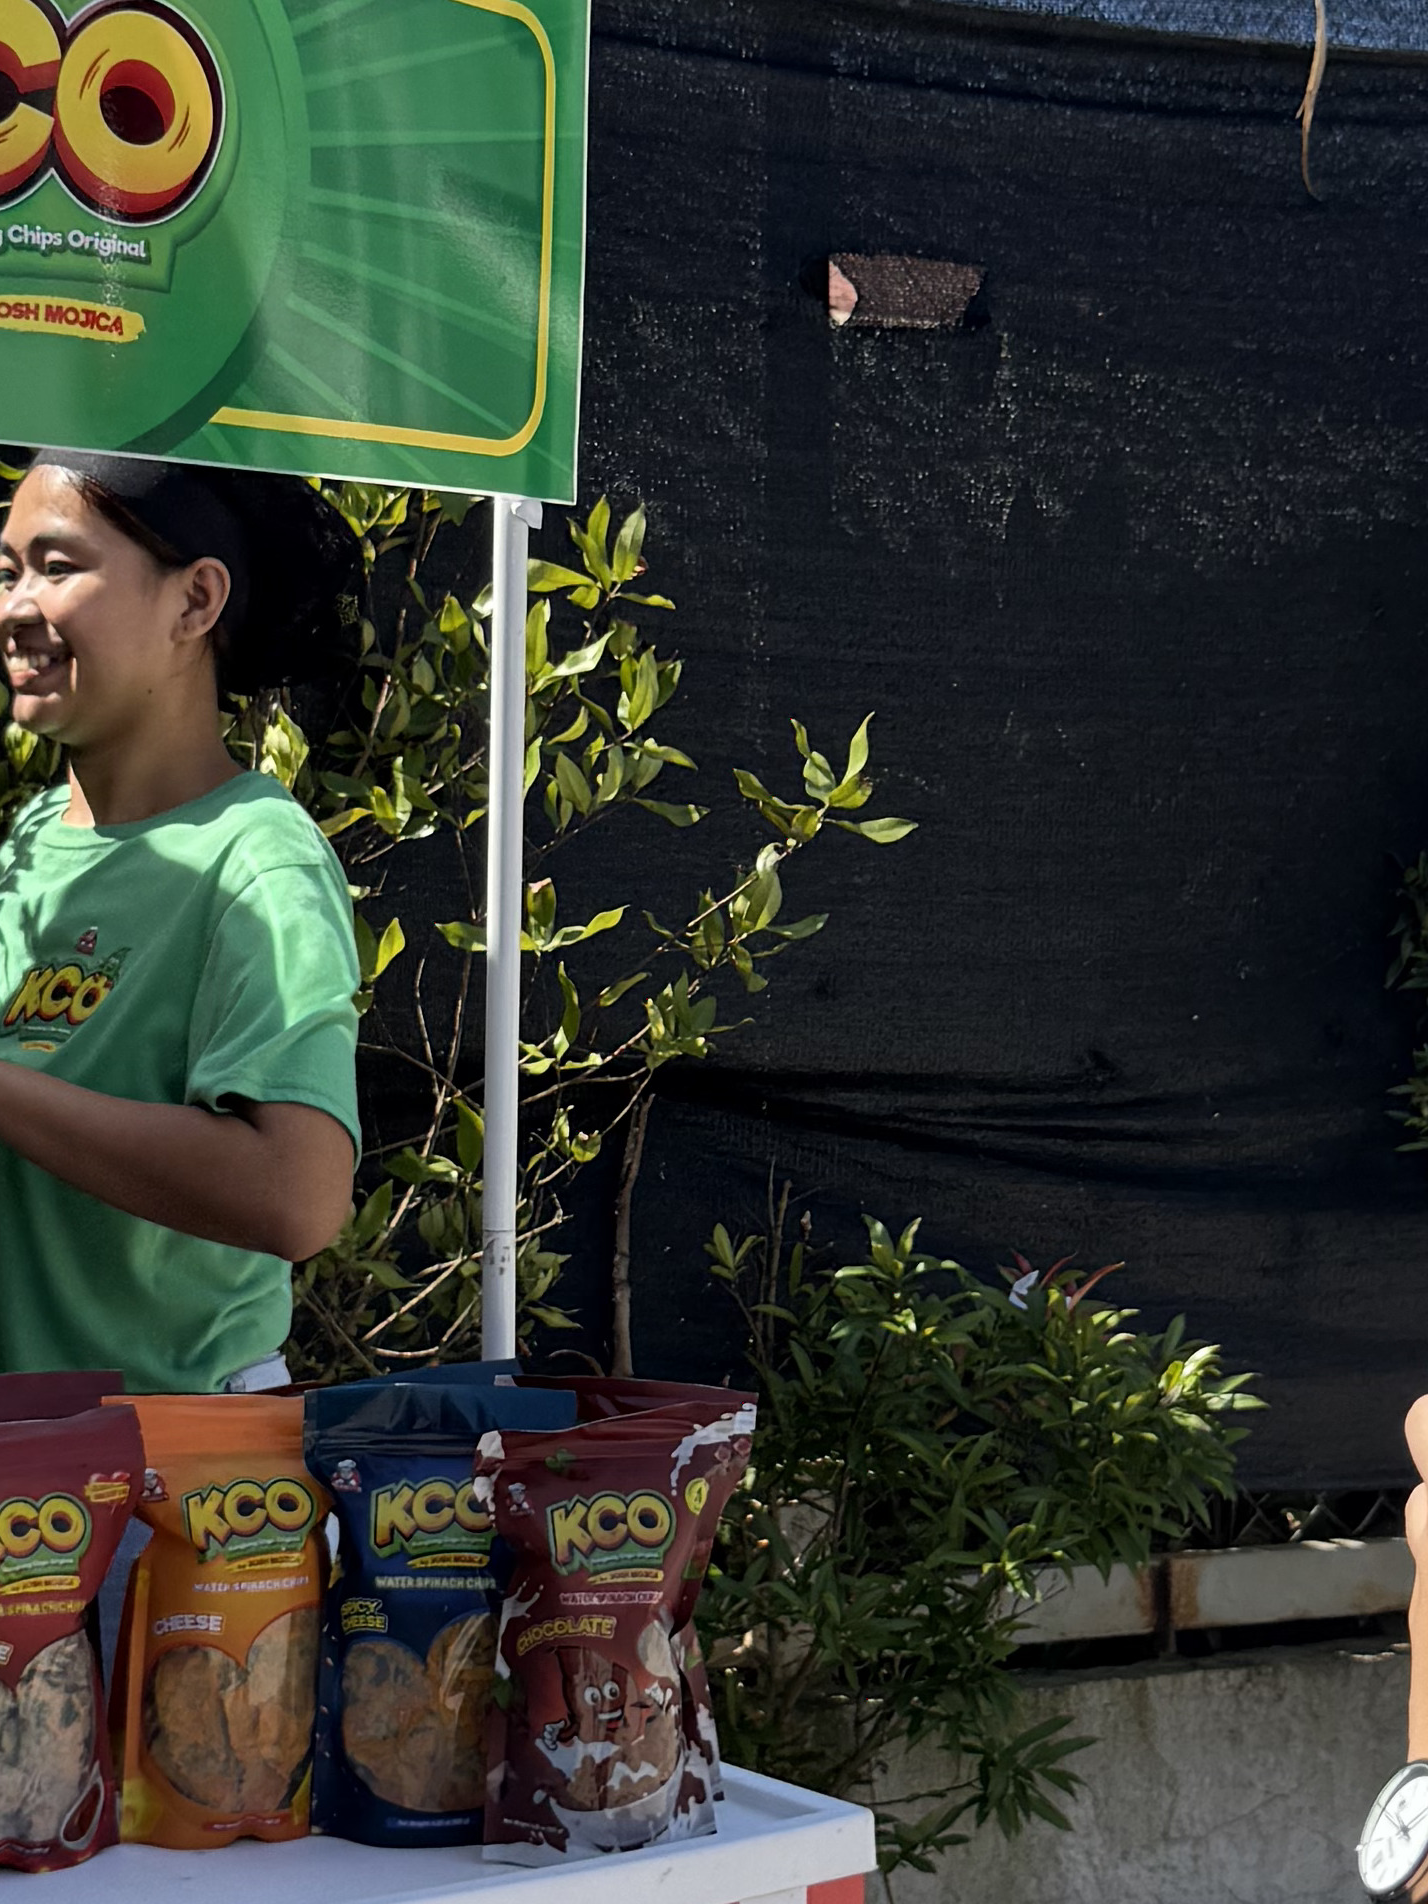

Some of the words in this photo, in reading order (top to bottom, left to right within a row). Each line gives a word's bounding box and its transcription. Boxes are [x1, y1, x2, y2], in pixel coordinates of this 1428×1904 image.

[8, 225, 62, 250] Chips
[68, 230, 147, 257] Original
[44, 304, 124, 335] MOJICA
[3, 963, 111, 1027] KCO
[188, 1480, 313, 1552] KCO
[553, 1494, 670, 1566] KCO
[375, 1577, 414, 1589] WATER
[154, 1614, 222, 1635] CHEESE
[517, 1618, 613, 1653] CHOCOLATE
